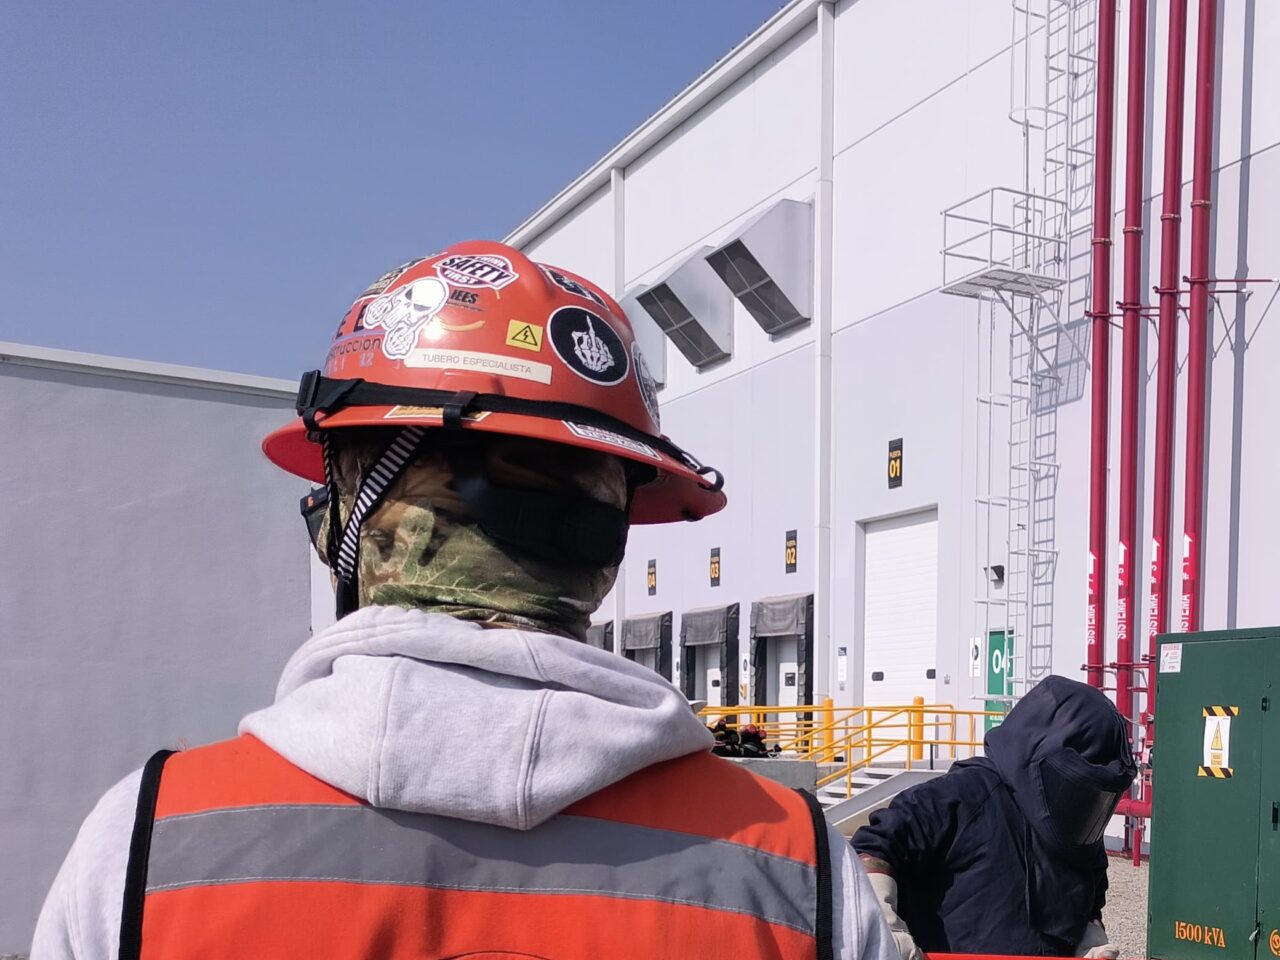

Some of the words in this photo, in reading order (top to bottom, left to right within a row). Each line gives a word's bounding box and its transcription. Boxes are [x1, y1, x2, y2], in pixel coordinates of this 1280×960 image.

[442, 258, 510, 283] SAFETY
[443, 270, 479, 284] FIRST
[450, 290, 479, 304] IEES
[422, 353, 460, 364] TUBERO
[462, 357, 532, 374] ESPECIALISTA
[890, 458, 900, 478] 01
[786, 547, 796, 564] 02
[711, 562, 719, 578] 03
[1117, 598, 1127, 640] SISTEMA
[1181, 593, 1190, 634] ISTEMA
[1088, 604, 1096, 645] SISTEMA
[1175, 920, 1202, 943] 1500
[1204, 926, 1226, 948] kVA
